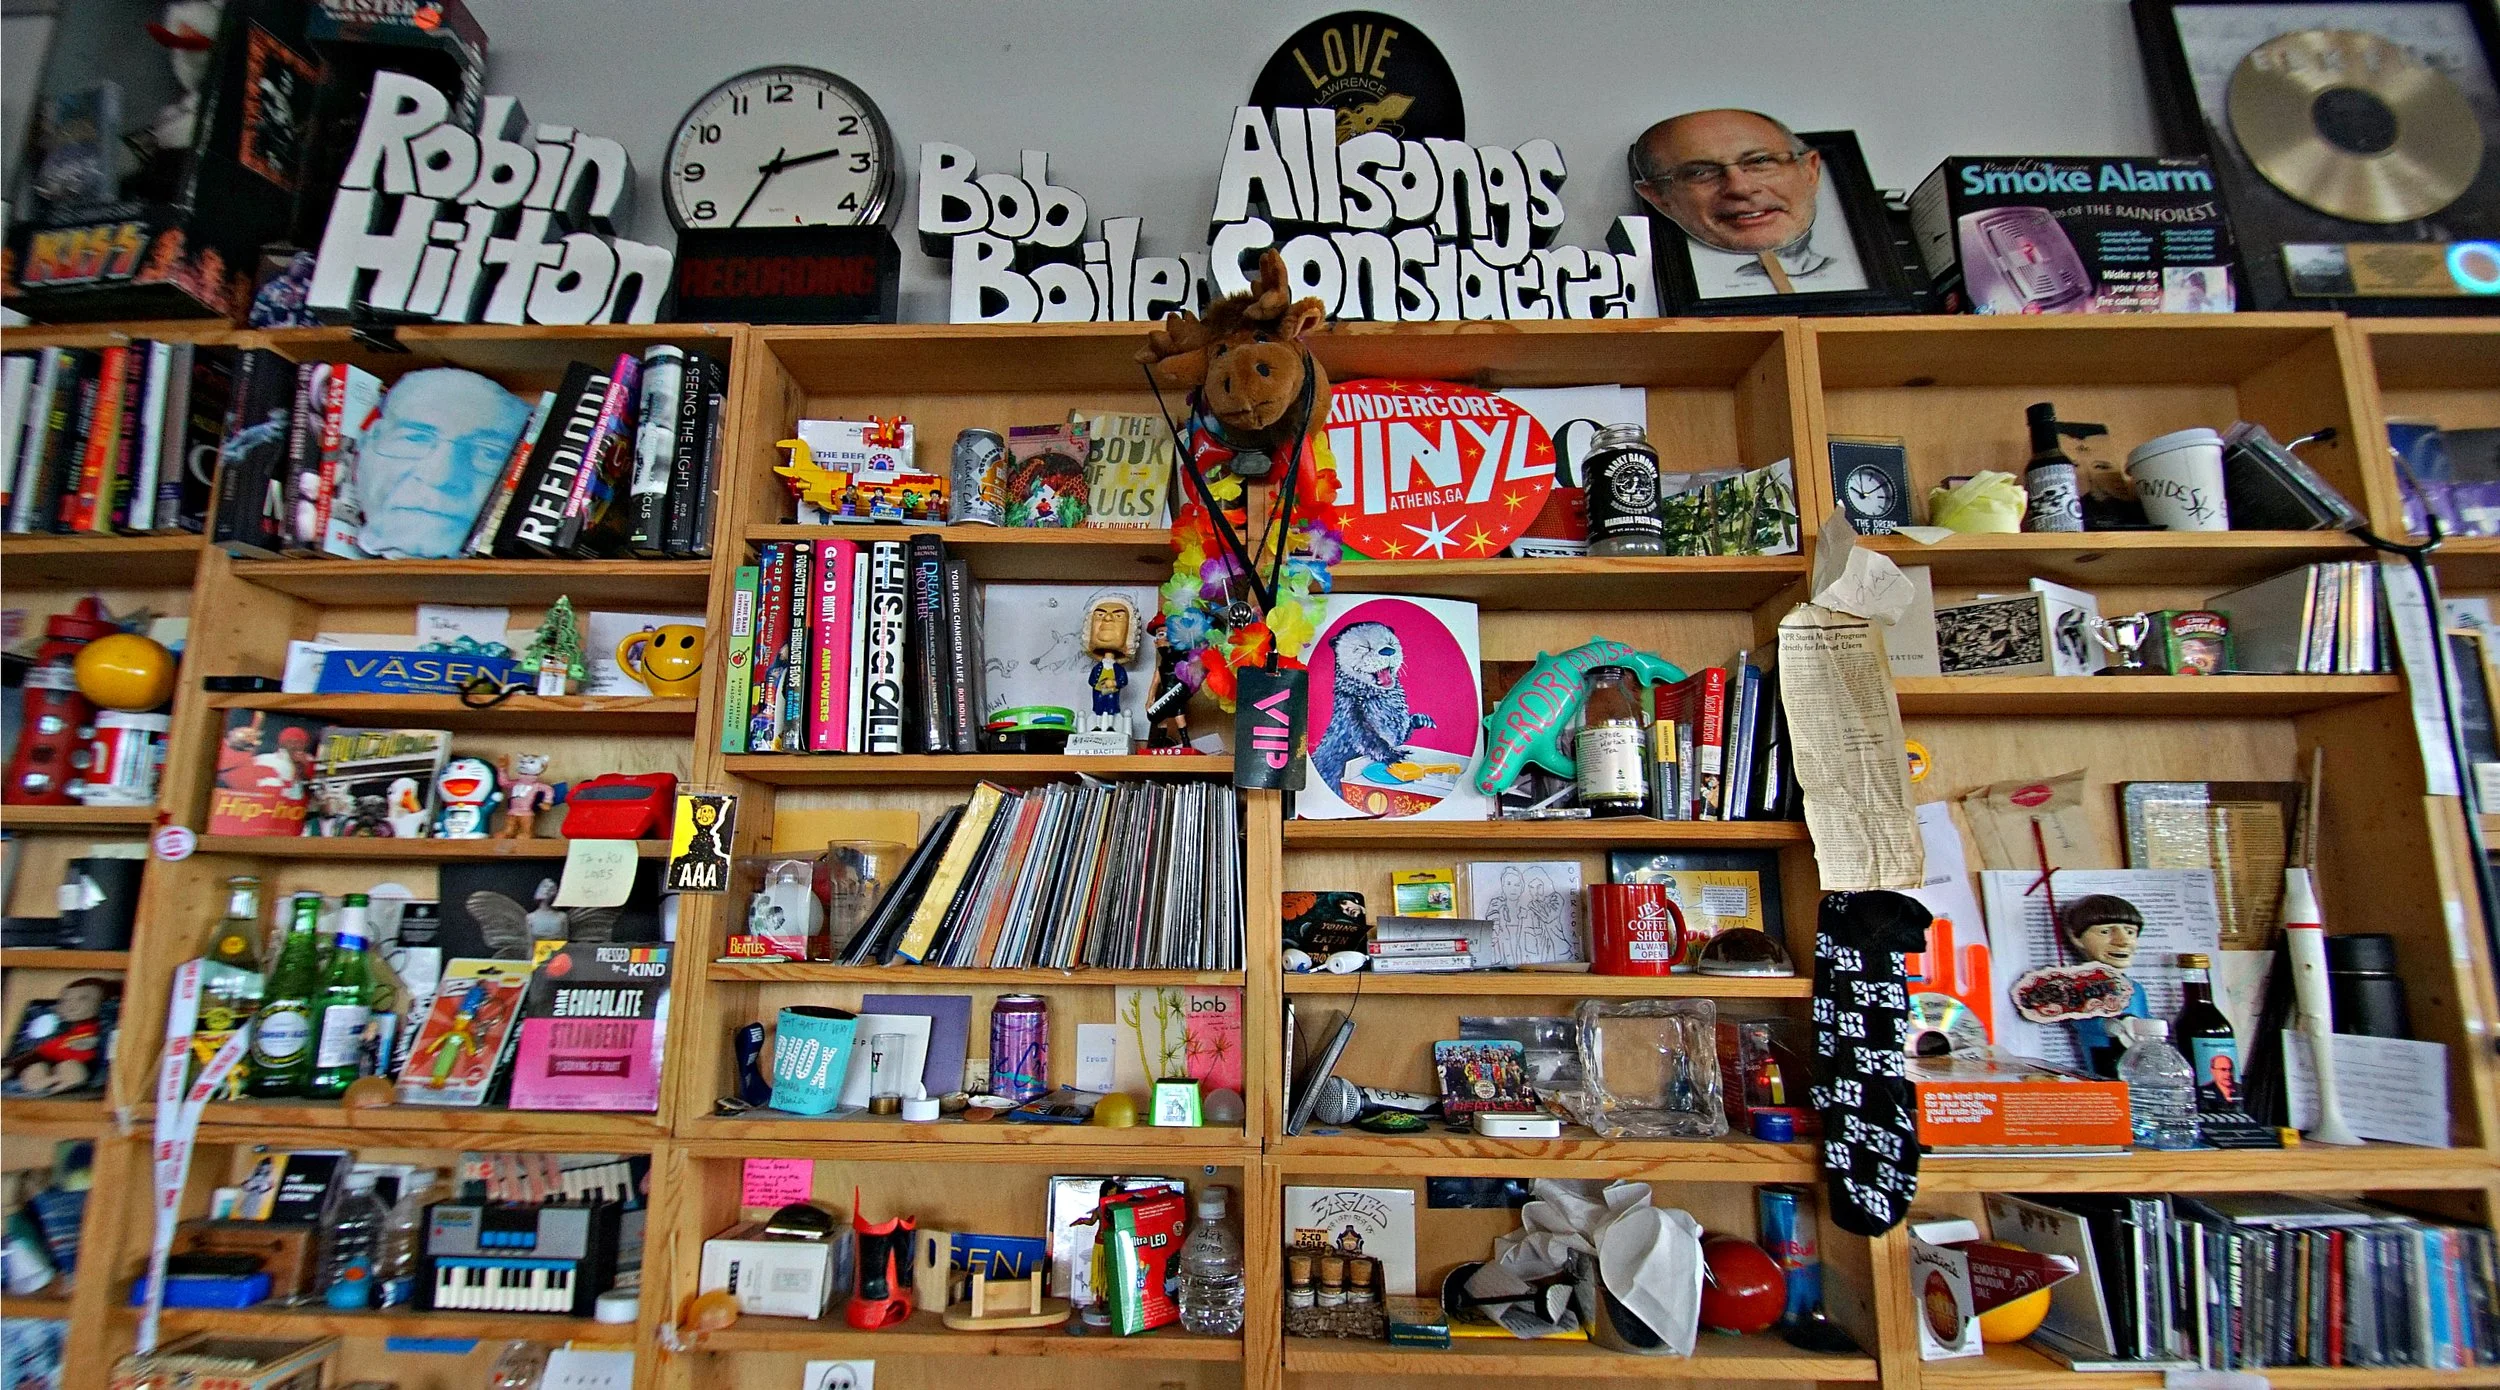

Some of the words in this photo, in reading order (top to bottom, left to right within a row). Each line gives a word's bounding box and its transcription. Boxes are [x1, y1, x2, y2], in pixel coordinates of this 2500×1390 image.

[1293, 24, 1398, 89] LOVE
[767, 84, 793, 104] 12
[818, 90, 823, 109] 1
[1314, 77, 1387, 104] LAWRENCE
[733, 96, 747, 115] 11
[700, 125, 720, 144] 10
[838, 116, 858, 135] 2
[340, 70, 629, 212] Robin
[684, 163, 705, 181] 9
[849, 153, 871, 173] 3
[1212, 105, 1565, 265] Allsongs
[1961, 163, 2092, 195] Smoke
[2098, 163, 2215, 195] Alarm
[838, 192, 858, 212] 4
[919, 142, 1087, 247] Bob
[694, 201, 717, 219] 8
[2067, 206, 2082, 216] OF
[2086, 204, 2111, 216] THE
[2116, 201, 2219, 224] RAINFOREST
[305, 191, 673, 325] Hilton
[680, 256, 876, 297] RECORDING
[2103, 270, 2131, 280] Wake
[2132, 271, 2146, 281] up
[2147, 270, 2159, 280] to
[2111, 284, 2135, 295] your
[2137, 283, 2160, 293] next
[683, 368, 700, 416] SEEING
[1325, 393, 1508, 423] KINDERCORE
[680, 418, 696, 443] THE
[1119, 416, 1154, 436] THE
[816, 451, 838, 459] THE
[676, 446, 691, 490] LIGHT
[1604, 454, 1628, 478] MARKY
[963, 492, 972, 514] CAN
[1854, 518, 1871, 528] THE
[1873, 519, 1898, 529] DREAM
[1862, 528, 1870, 536] IS
[794, 555, 808, 597] FORGOTTEN
[823, 546, 838, 592] GOOD
[771, 552, 785, 611] nearest
[922, 562, 939, 610] DREAM
[951, 569, 959, 590] YOUR
[915, 567, 928, 621] BROTHER
[952, 593, 960, 613] SONG
[741, 600, 750, 616] INDIE
[793, 598, 806, 616] FADS
[820, 595, 837, 623] BOOTY
[953, 615, 962, 650] CHANGED
[1782, 633, 1796, 642] NPR
[1796, 633, 1814, 641] Starts
[1834, 632, 1867, 643] Program
[762, 645, 772, 667] place
[790, 628, 804, 664] FABULOUS
[1782, 643, 1804, 652] Strictly
[1805, 643, 1814, 651] for
[1841, 642, 1862, 651] Users
[820, 648, 832, 671] ANN
[955, 653, 963, 664] MY
[788, 665, 801, 687] FLOPS
[956, 666, 964, 683] LIFE
[818, 673, 832, 722] POWERS
[957, 688, 965, 702] BOB
[1710, 694, 1722, 715] Susan
[865, 679, 903, 753] CALL
[1252, 688, 1291, 770] VIP
[1599, 731, 1623, 739] Steve
[1705, 712, 1721, 744] Andersen
[679, 862, 717, 887] AAA
[1321, 922, 1358, 931] YOUNG
[1628, 920, 1667, 931] COFFEE
[730, 936, 766, 956] BEATLES
[1313, 935, 1349, 945] LATIN
[1634, 942, 1666, 950] ALWAYS
[1636, 931, 1664, 941] SHOP
[628, 963, 666, 976] KIND
[567, 988, 644, 1017] CHOCOLATE
[1191, 996, 1226, 1012] bob
[550, 1022, 638, 1048] STRAWBERRY
[1086, 1055, 1108, 1063] from
[1937, 1092, 1952, 1100] the
[1953, 1092, 1972, 1100] kind
[1973, 1092, 1997, 1102] thing
[1939, 1101, 1958, 1110] your
[1150, 1234, 1167, 1248] LED
[1301, 1233, 1322, 1241] 2-CD
